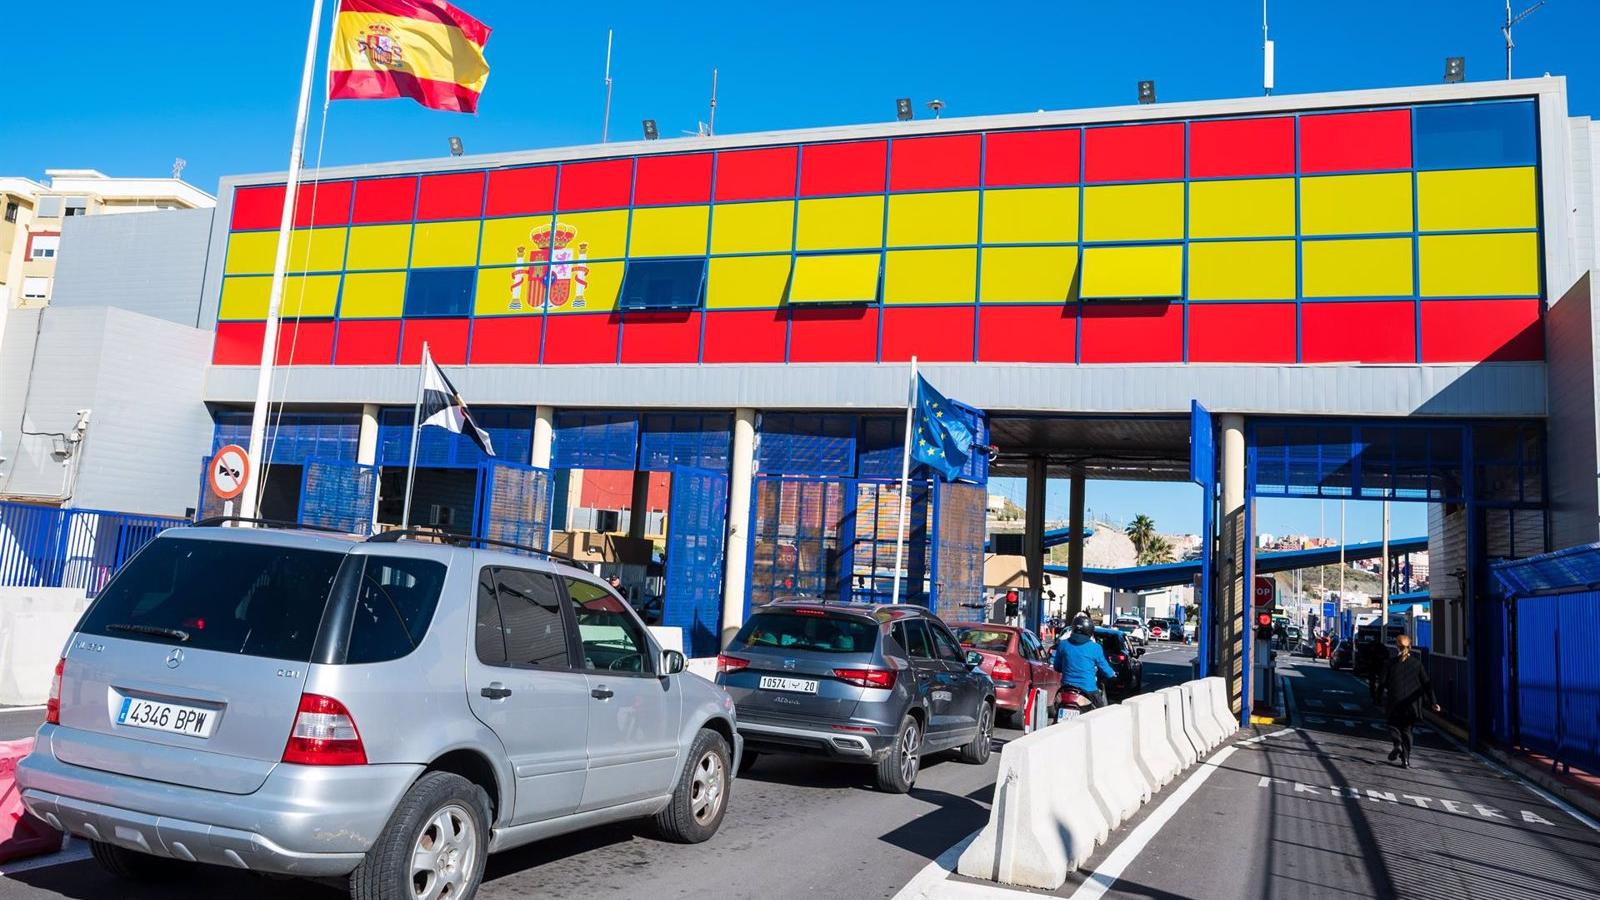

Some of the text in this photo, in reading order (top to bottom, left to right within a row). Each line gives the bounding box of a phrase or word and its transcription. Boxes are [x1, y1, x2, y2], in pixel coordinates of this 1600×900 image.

[1256, 587, 1270, 596] OP
[762, 677, 786, 689] 10574
[804, 681, 815, 691] 20
[130, 702, 207, 733] 4346 BPW
